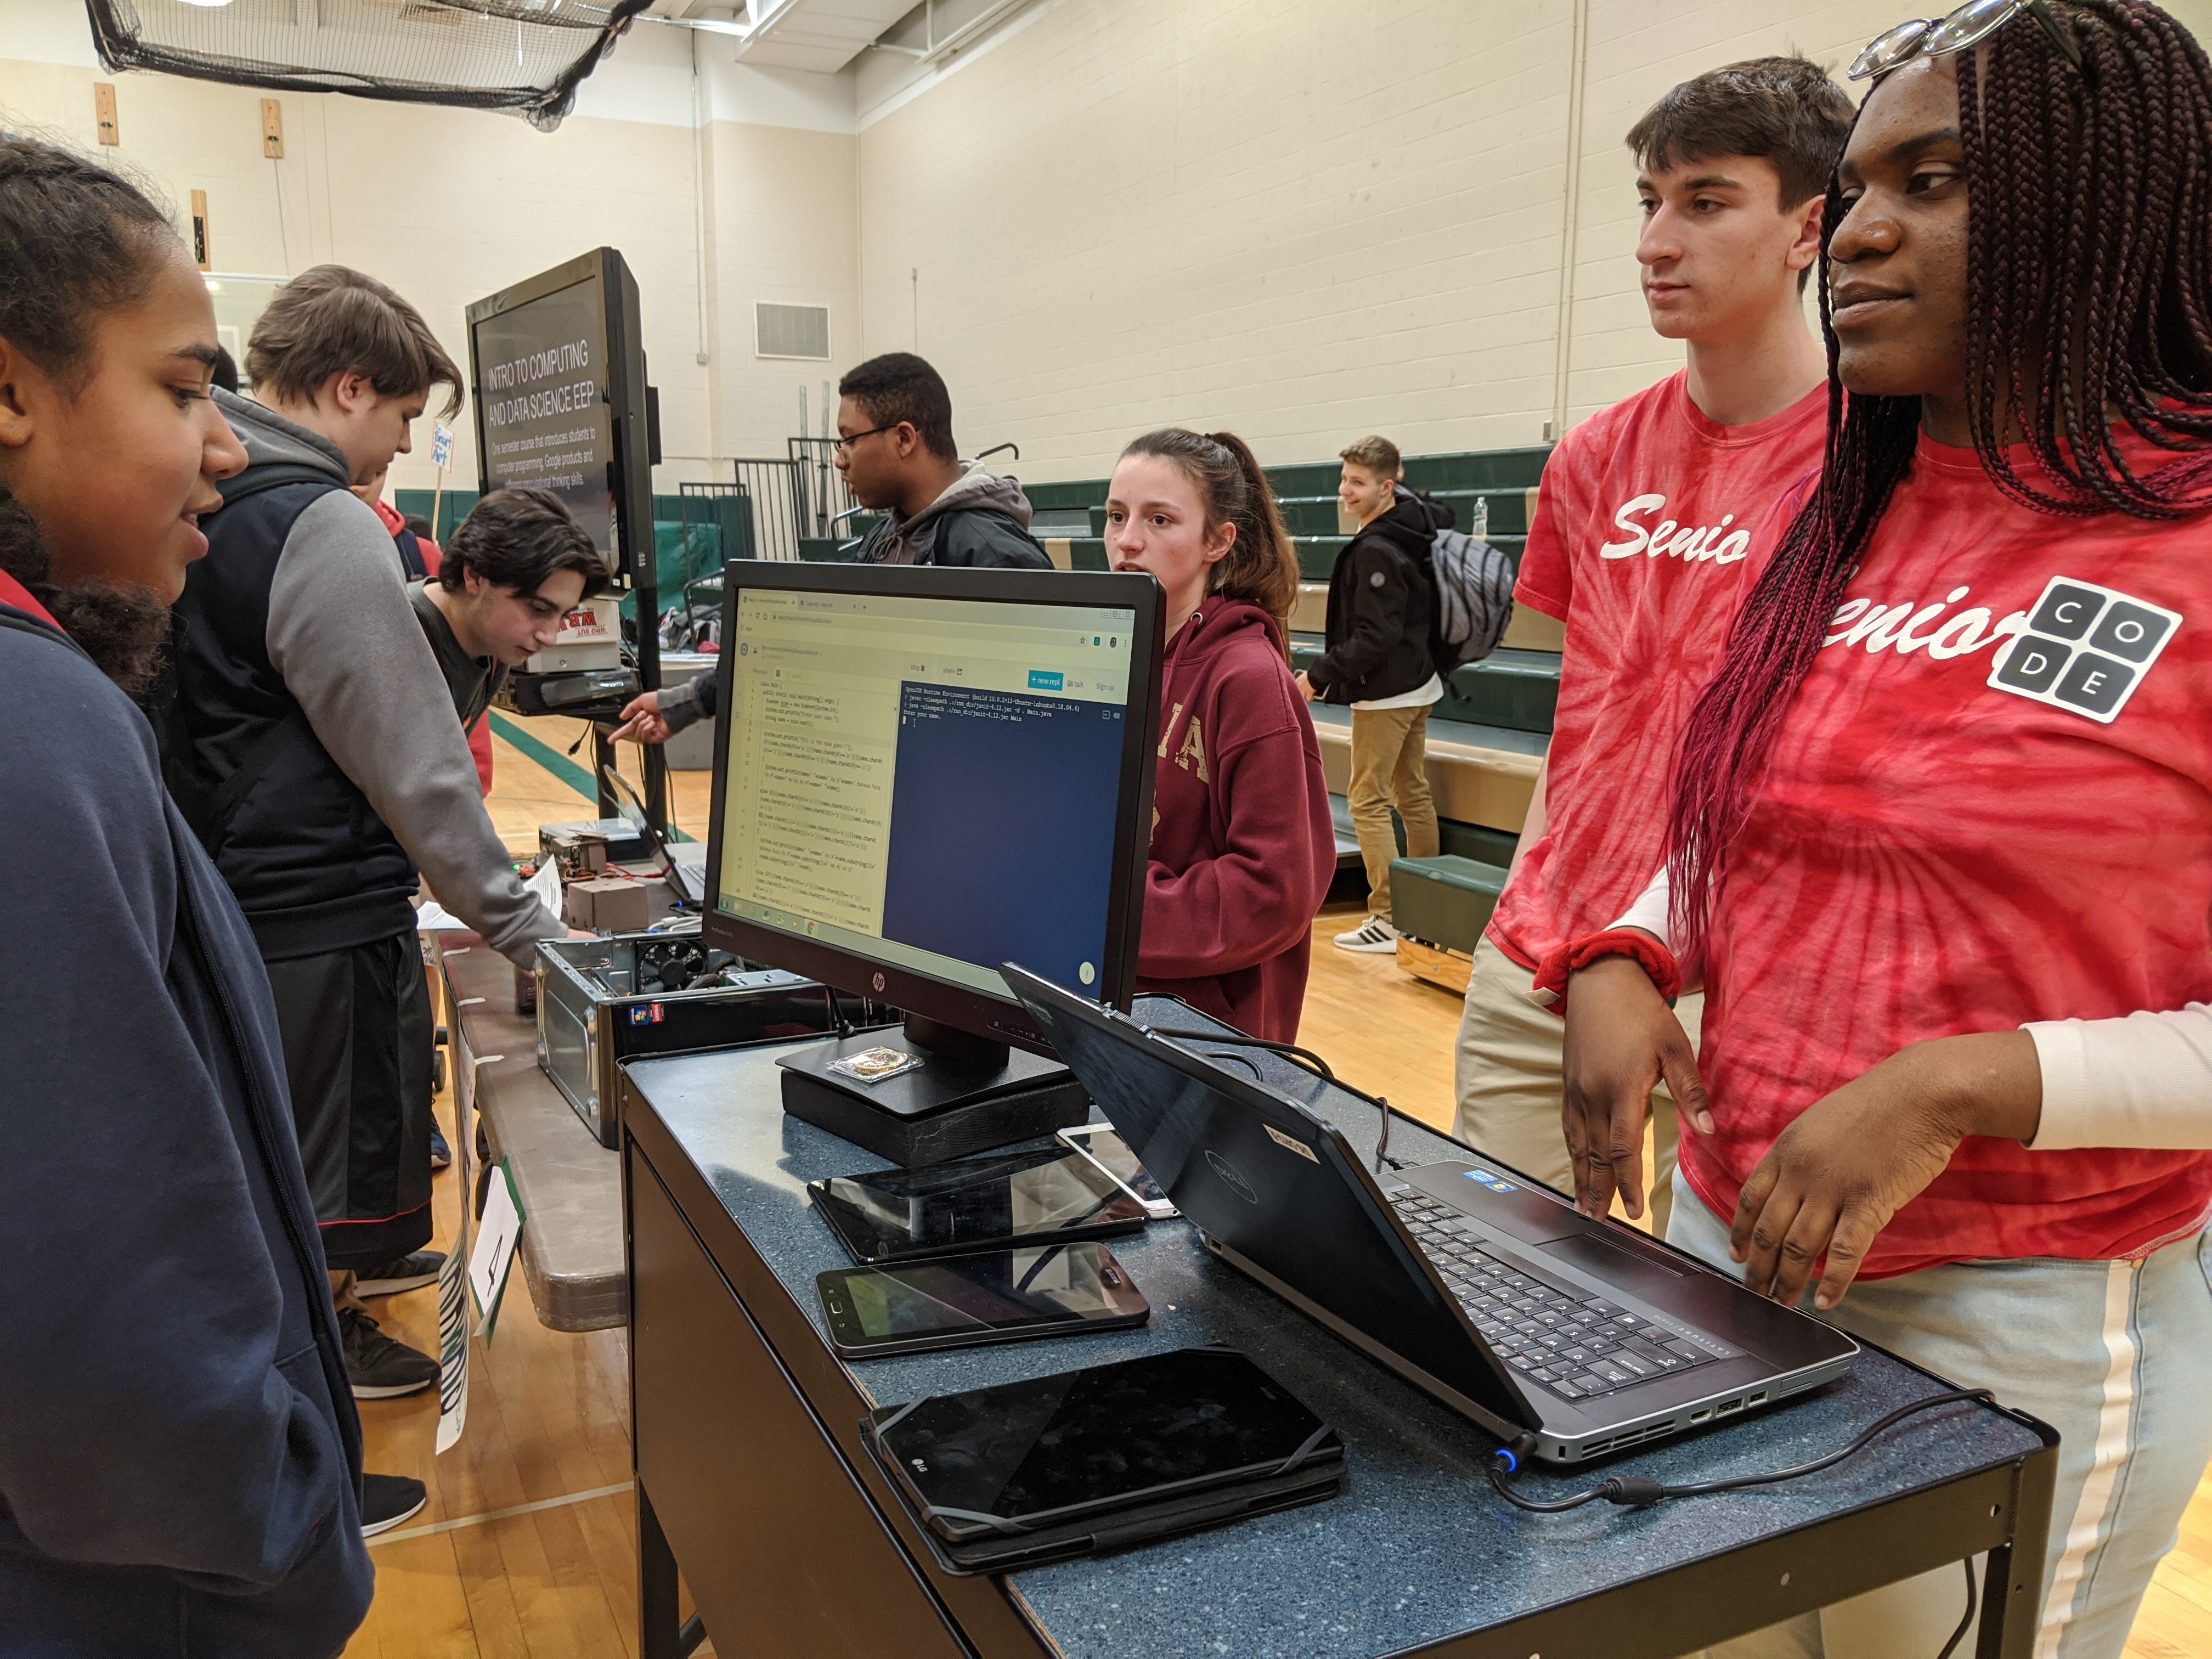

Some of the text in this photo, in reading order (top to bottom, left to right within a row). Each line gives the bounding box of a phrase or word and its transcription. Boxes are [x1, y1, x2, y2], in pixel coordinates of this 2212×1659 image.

[489, 339, 588, 392] INTRO TO COMPUTING
[489, 380, 594, 427] AND DATA SCIENCE EEP
[501, 440, 519, 454] semester
[521, 438, 534, 450] course
[535, 435, 544, 448] that
[545, 432, 568, 446] introduces
[569, 427, 589, 443] students
[590, 426, 595, 439] to
[496, 461, 515, 475] computer
[545, 454, 561, 470] Google
[562, 450, 583, 469] products
[584, 448, 593, 462] and
[552, 473, 570, 489] thinking
[1600, 494, 1751, 565] Senio
[1821, 582, 2027, 670] enior
[943, 691, 970, 699] Environment
[1096, 683, 1107, 691] Sign
[1027, 709, 1052, 717] Main.java
[1678, 1327, 1730, 1355] LATITUDE
